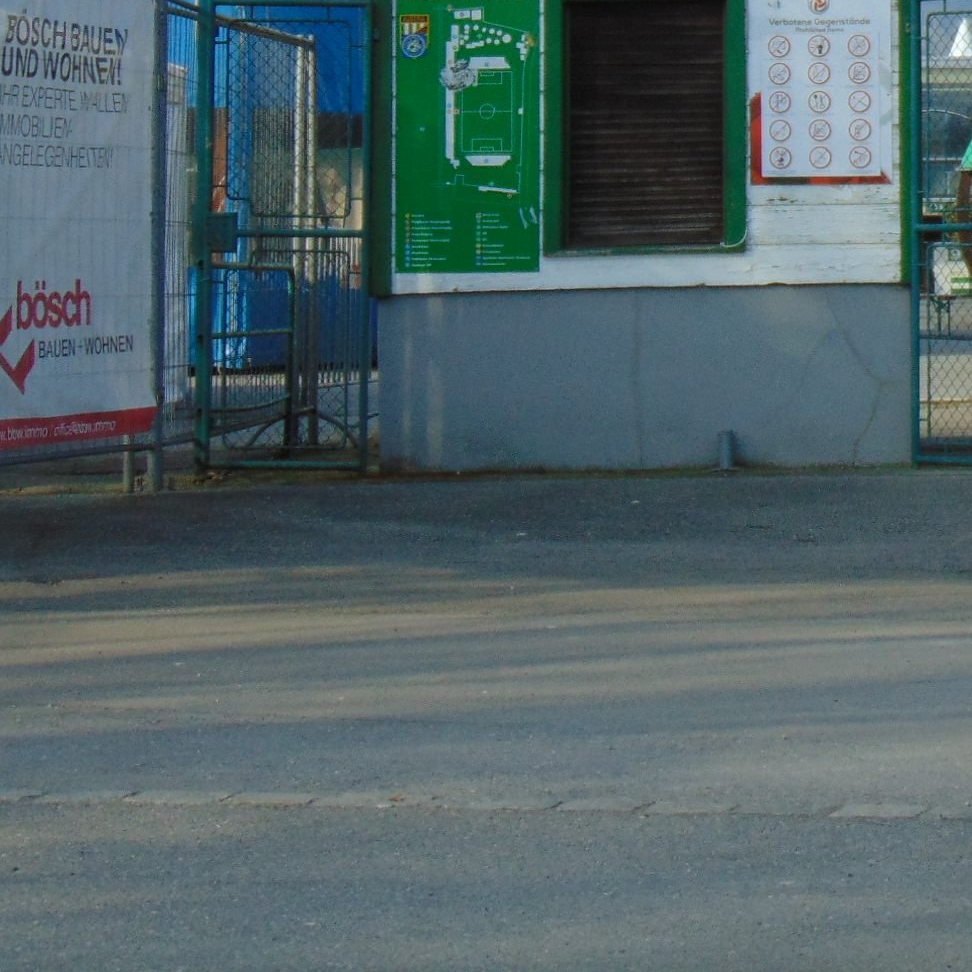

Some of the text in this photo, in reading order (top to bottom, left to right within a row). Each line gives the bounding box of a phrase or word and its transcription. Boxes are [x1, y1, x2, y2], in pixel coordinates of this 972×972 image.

[5, 8, 129, 56] BÖSCH BAUEN
[1, 45, 123, 86] UND WOHNEN!
[22, 85, 77, 111] EXPERTE
[17, 279, 92, 330] bösch
[38, 338, 76, 359] BAUEN
[84, 334, 134, 355] WOHNEN
